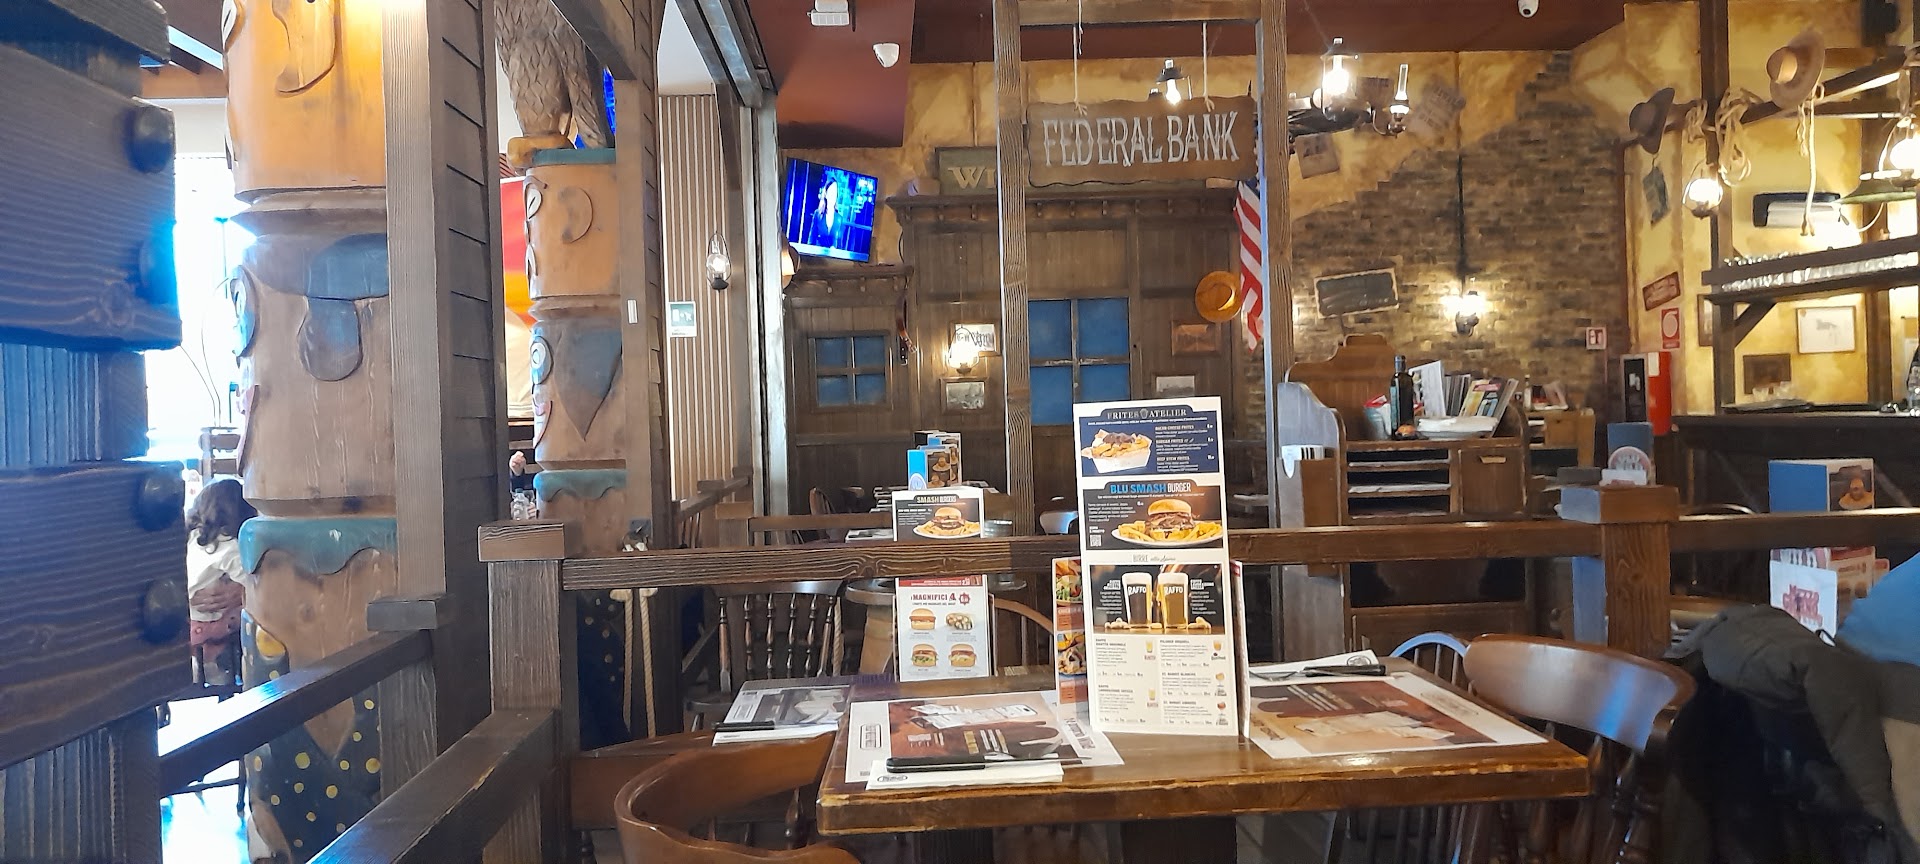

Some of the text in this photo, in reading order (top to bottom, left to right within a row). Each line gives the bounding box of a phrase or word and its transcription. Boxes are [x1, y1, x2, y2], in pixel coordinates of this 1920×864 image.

[1042, 110, 1240, 168] FEDERAL BANK
[1107, 409, 1188, 420] FRITES ATELIER
[1110, 482, 1192, 494] BLU SMASH BURGER
[1127, 586, 1147, 596] RAFFO
[1163, 586, 1184, 595] RAFFO
